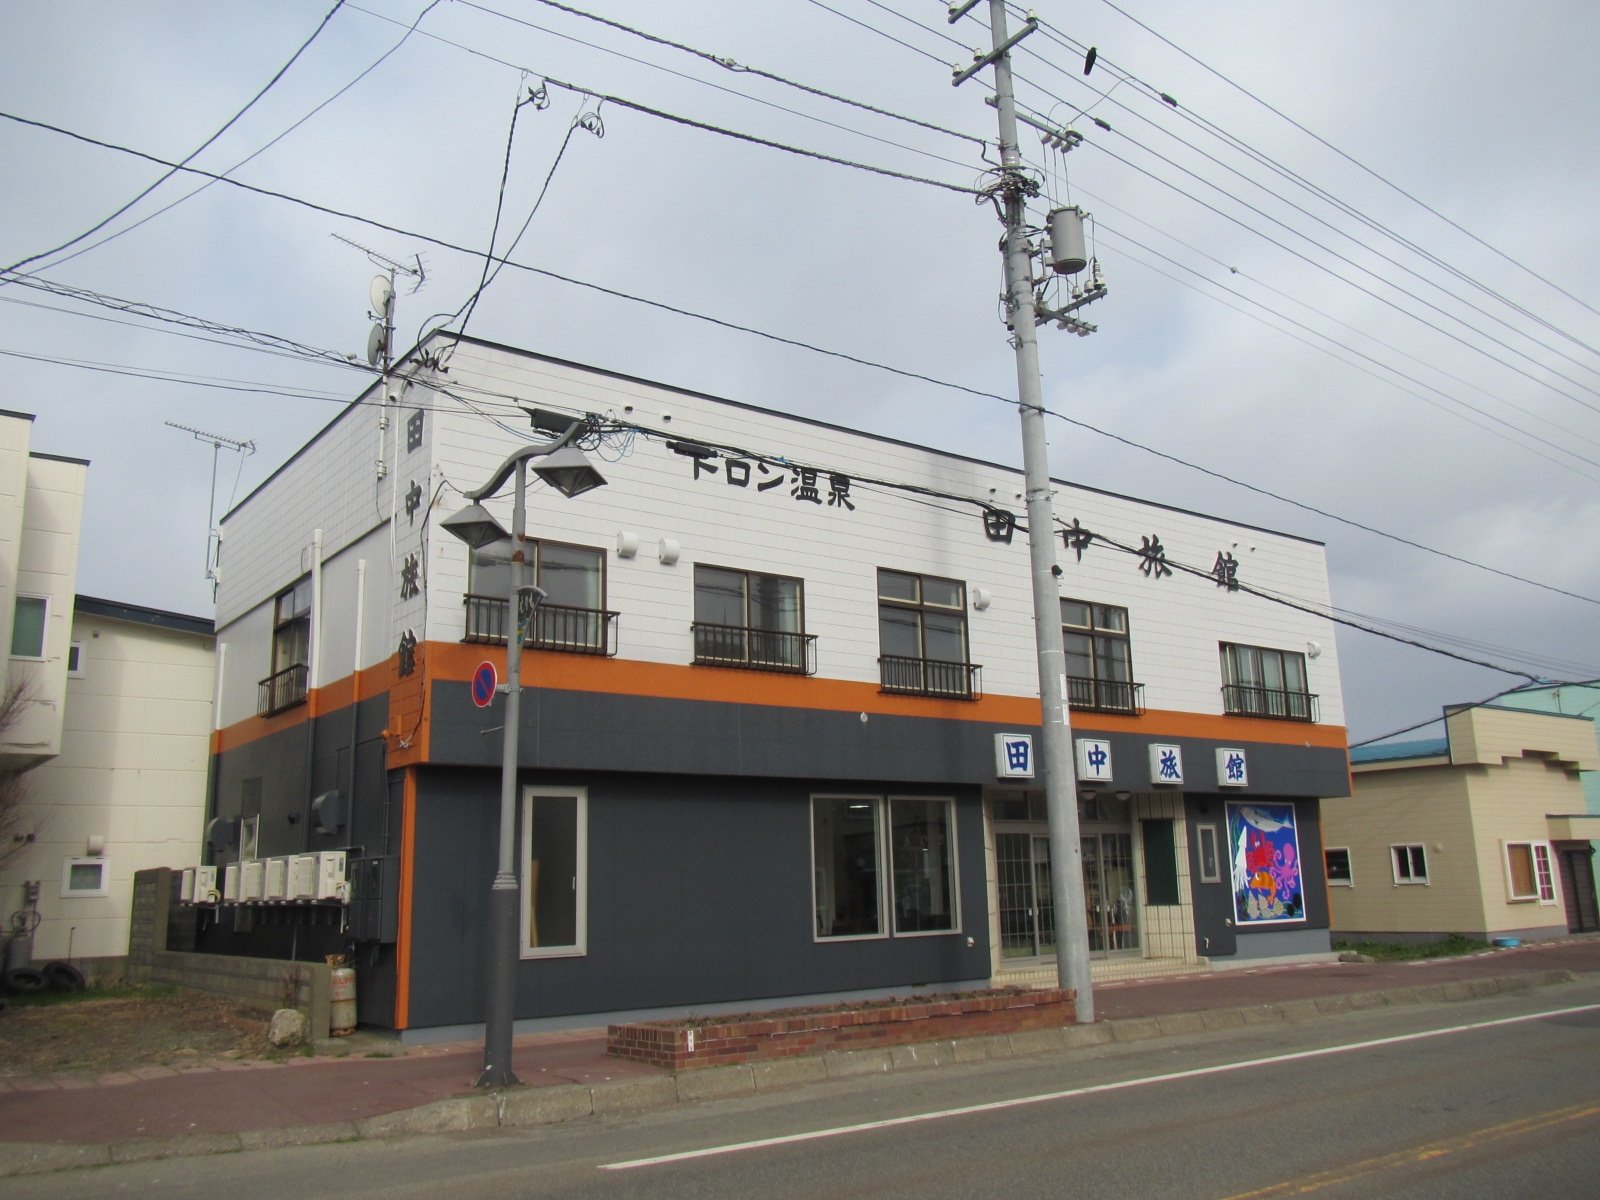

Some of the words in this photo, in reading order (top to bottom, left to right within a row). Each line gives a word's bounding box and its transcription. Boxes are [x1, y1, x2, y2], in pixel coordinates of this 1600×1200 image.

[693, 456, 855, 511] トロン温泉
[1006, 740, 1244, 781] 田中旅館
